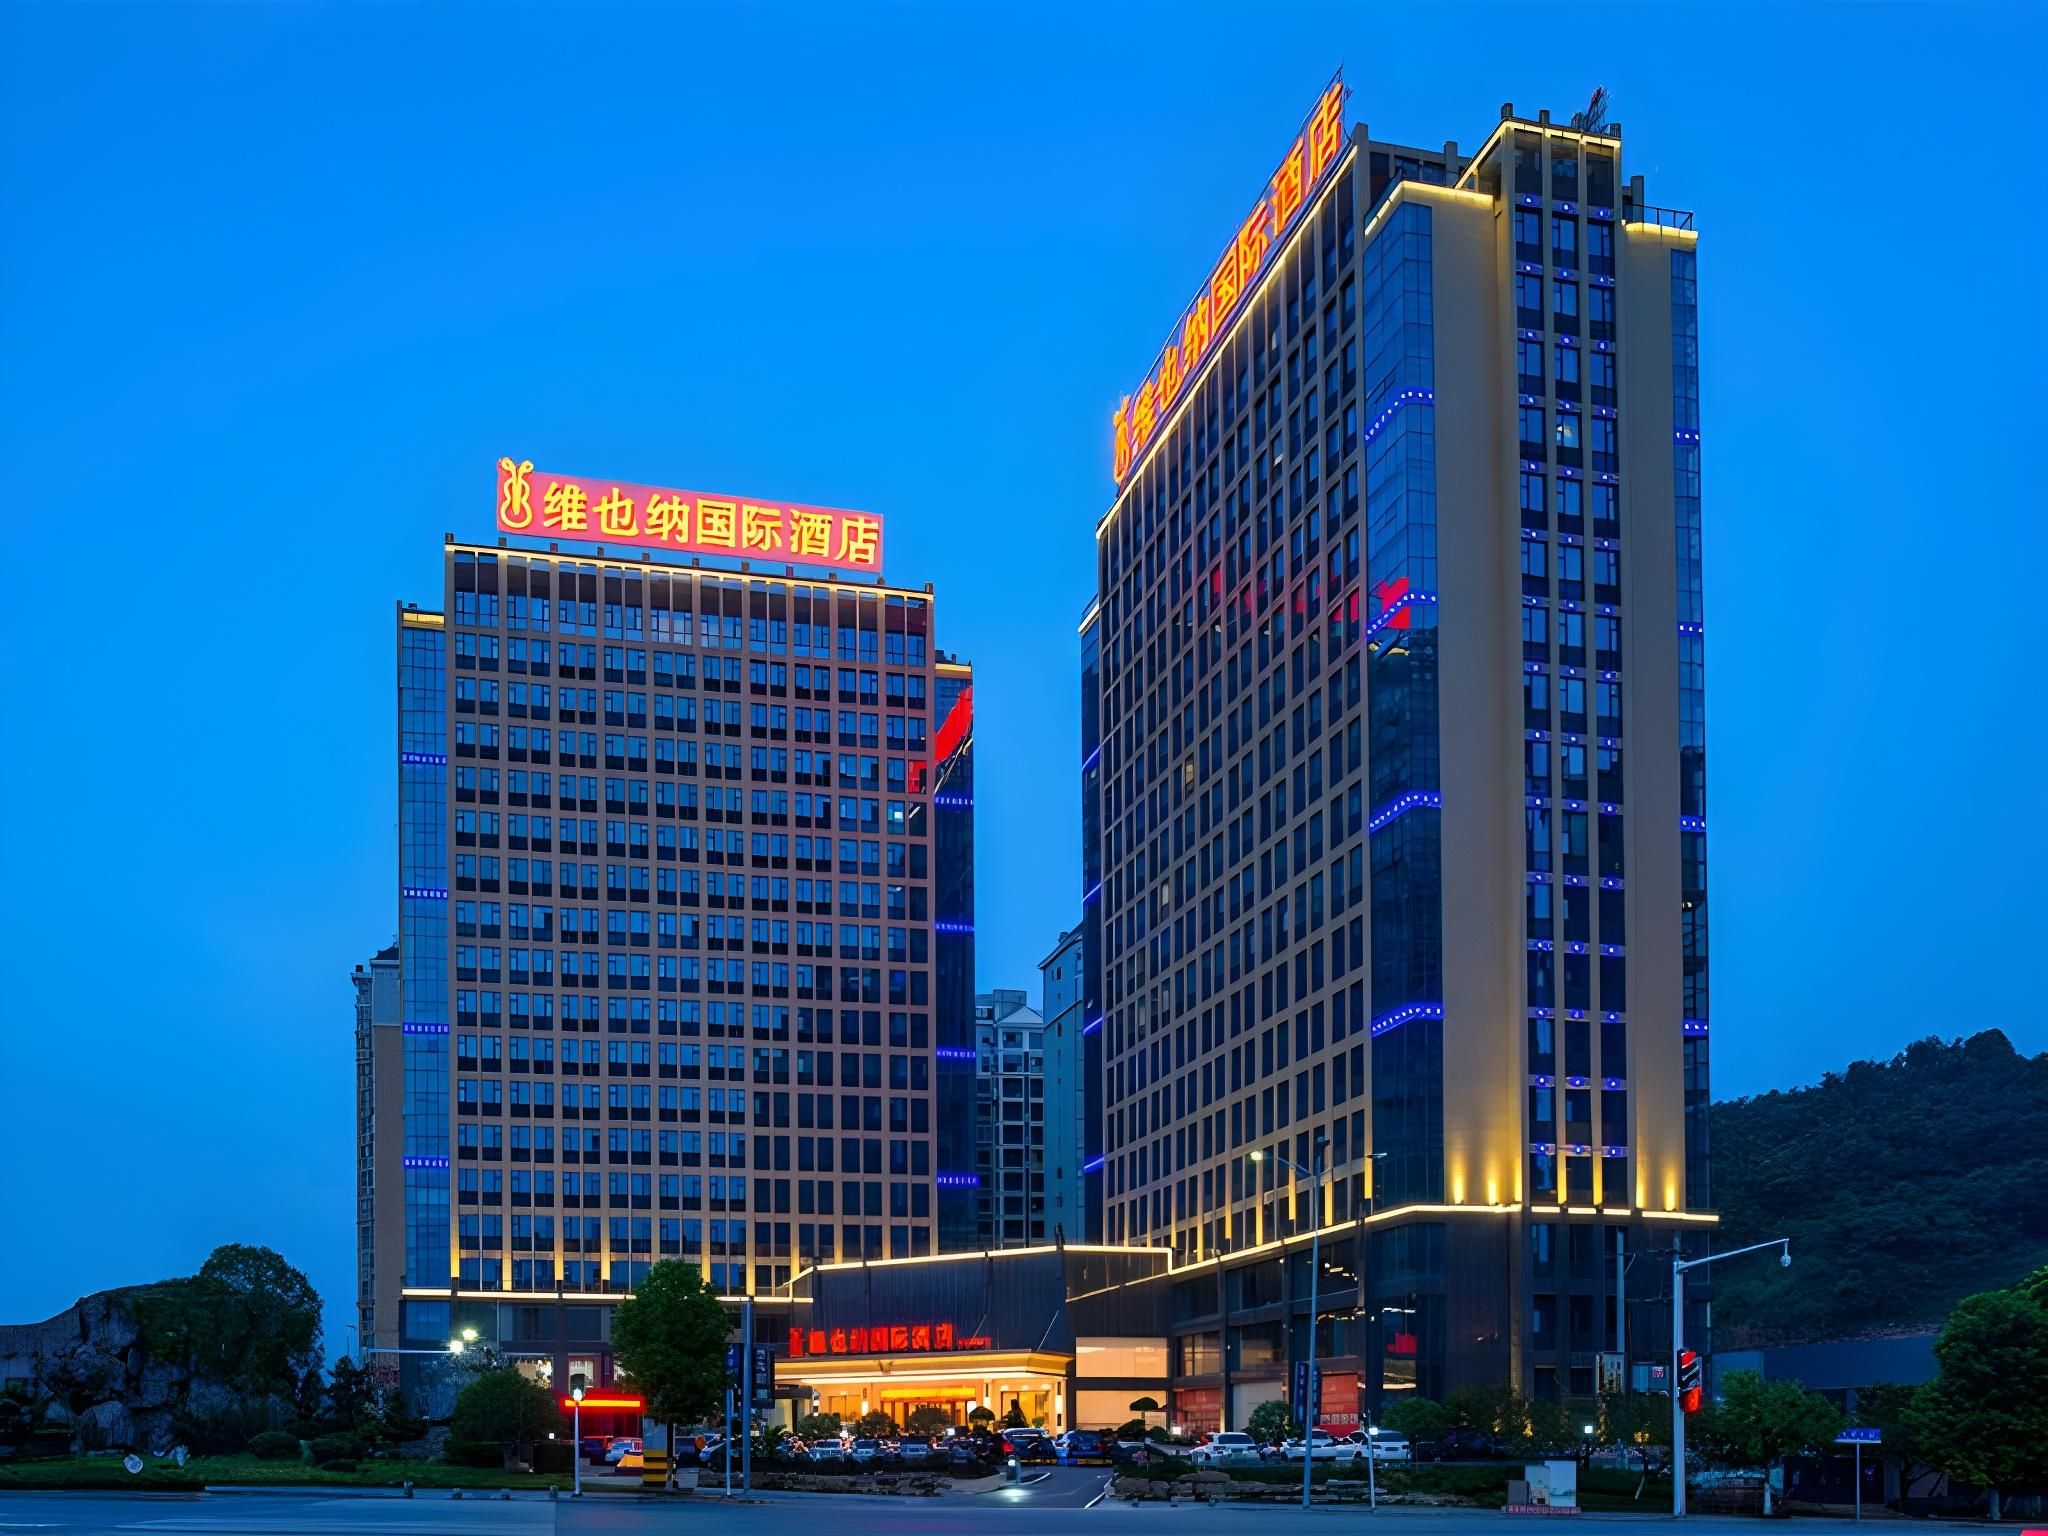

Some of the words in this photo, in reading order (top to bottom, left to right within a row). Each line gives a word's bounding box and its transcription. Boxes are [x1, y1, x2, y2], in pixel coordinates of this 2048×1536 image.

[543, 481, 880, 565] 维也纳国际酒店
